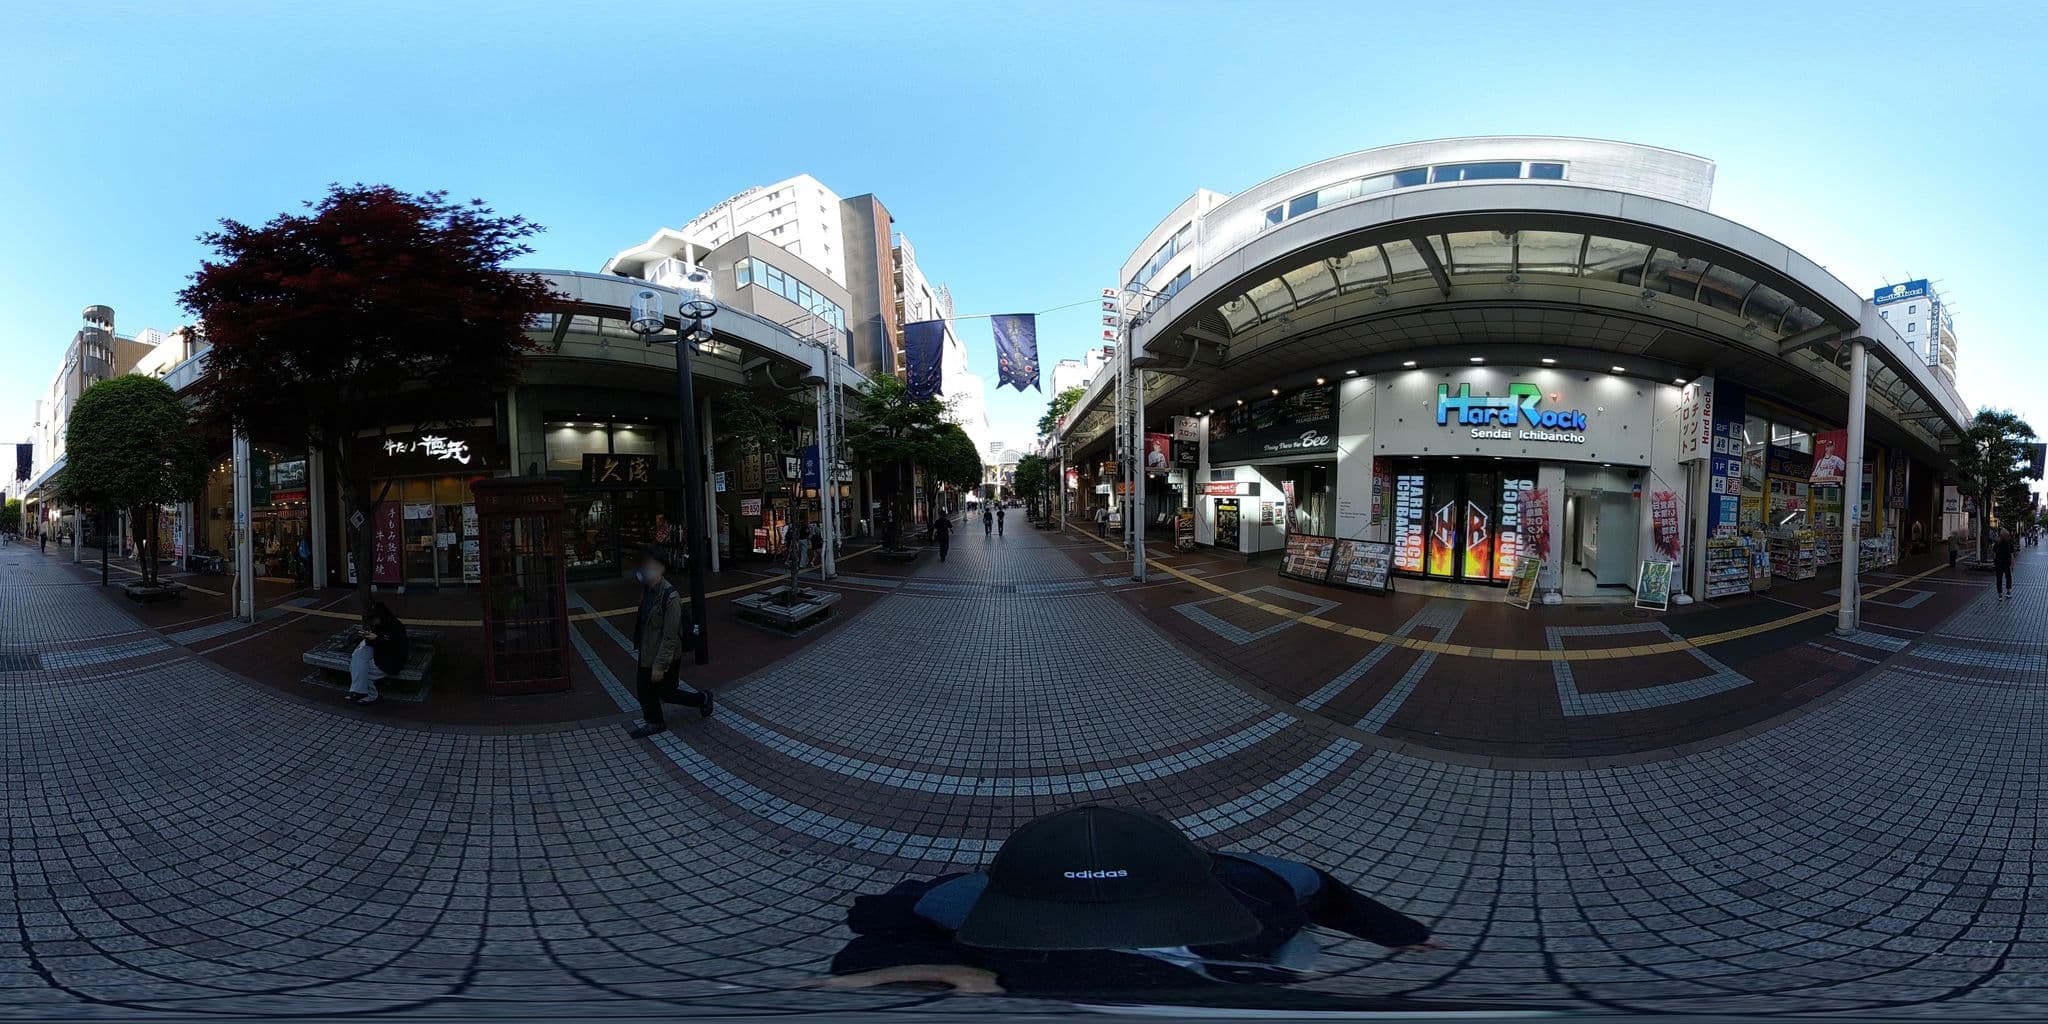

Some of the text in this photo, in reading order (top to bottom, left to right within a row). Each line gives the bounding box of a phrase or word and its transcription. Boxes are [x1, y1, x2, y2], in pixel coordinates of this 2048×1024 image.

[1300, 430, 1331, 447] Bee
[1470, 428, 1586, 444] Sendai Ichibancho
[1682, 391, 1690, 454] スロット
[1701, 390, 1712, 445] Hard Rock
[1715, 461, 1726, 471] 1F
[1394, 475, 1411, 567] ICHIBANCHO
[1408, 475, 1425, 569] HARD ROCK
[1499, 478, 1520, 577] HARD ROCK
[375, 528, 386, 576] 牛たん焼
[1063, 869, 1128, 879] adidas
